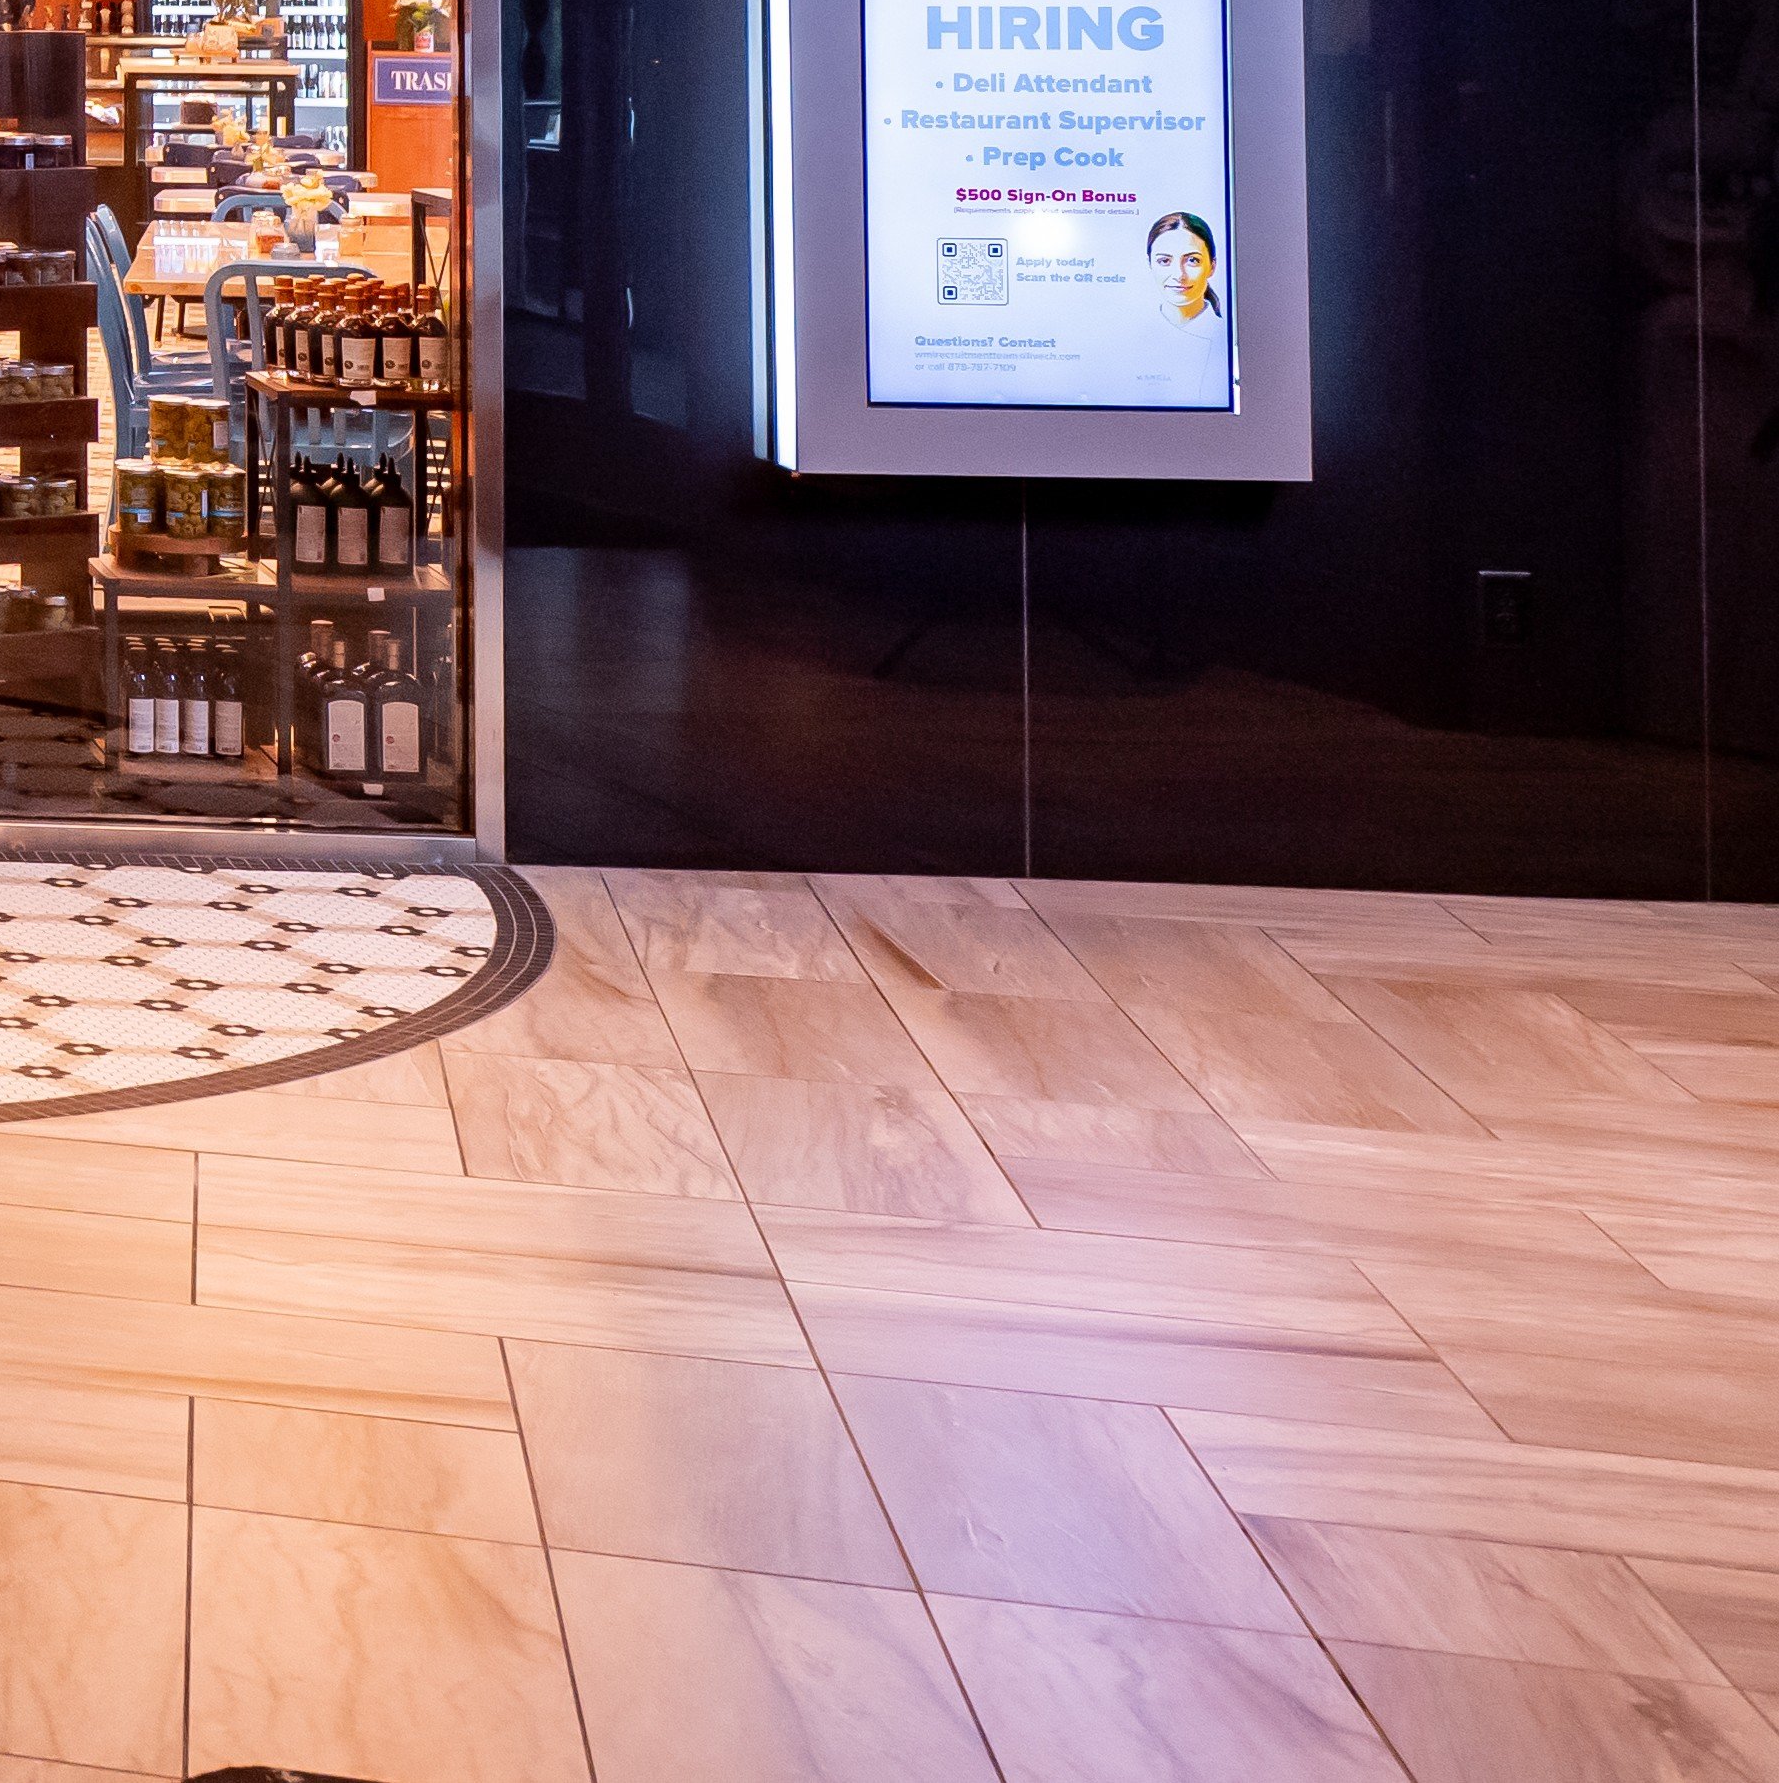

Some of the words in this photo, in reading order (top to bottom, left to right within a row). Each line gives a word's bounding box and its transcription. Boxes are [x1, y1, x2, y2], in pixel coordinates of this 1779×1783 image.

[927, 6, 1164, 51] HIRING
[953, 73, 1005, 93] Deli
[1014, 74, 1153, 93] Attendant
[901, 109, 1051, 130] Restaurant
[1059, 110, 1206, 134] Supervisor
[983, 146, 1046, 170] Prep
[1054, 147, 1124, 167] Cook
[956, 187, 1002, 202] $500
[1007, 188, 1076, 204] Sign-On
[1082, 189, 1137, 203] Bonus
[1016, 256, 1052, 268] Apply
[1056, 257, 1095, 269] today!
[1016, 272, 1046, 283] Scan
[1050, 273, 1071, 283] the
[1074, 273, 1093, 284] QR
[1096, 274, 1126, 284] code
[915, 335, 994, 348] Questions?
[999, 335, 1056, 348] Contact
